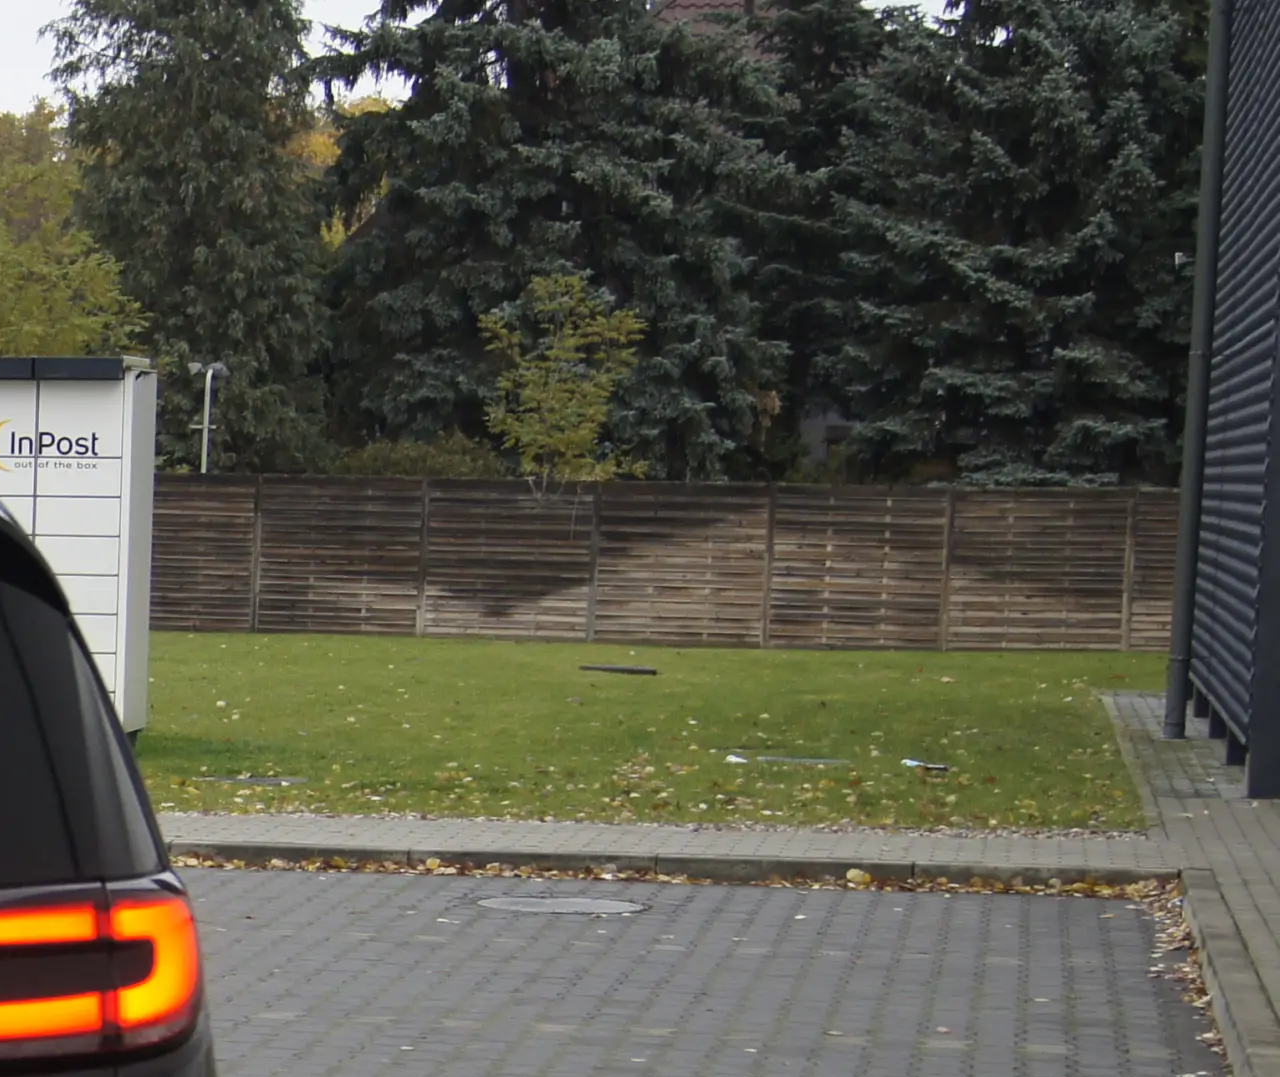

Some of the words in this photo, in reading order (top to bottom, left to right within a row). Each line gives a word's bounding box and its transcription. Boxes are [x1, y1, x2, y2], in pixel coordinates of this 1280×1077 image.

[10, 431, 100, 456] InPost
[14, 461, 33, 469] out
[38, 460, 50, 469] of
[53, 460, 73, 469] the
[77, 460, 98, 470] box
